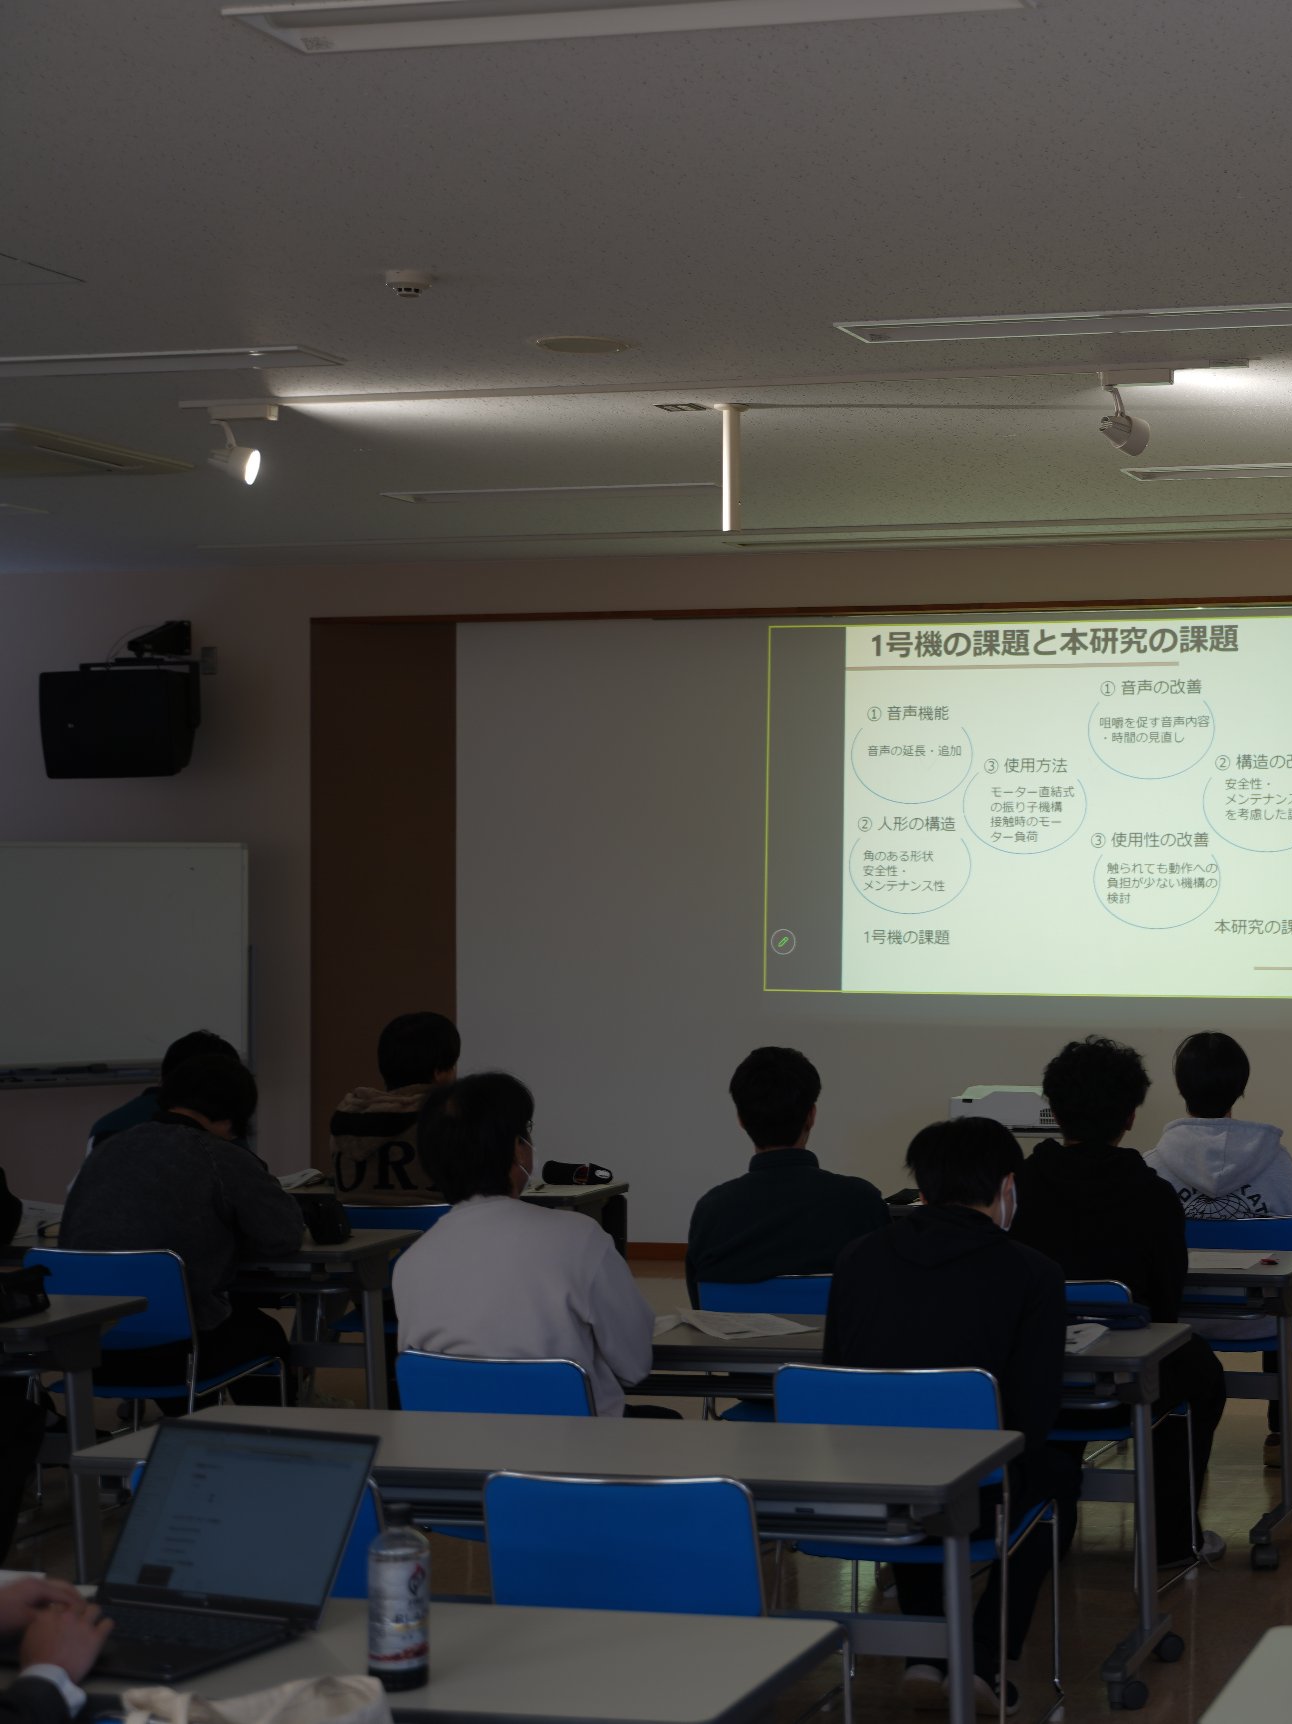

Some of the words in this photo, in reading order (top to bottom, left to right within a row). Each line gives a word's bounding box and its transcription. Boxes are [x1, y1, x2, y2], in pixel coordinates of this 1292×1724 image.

[871, 624, 1239, 658] 1号機の課題と本研究の課題
[1121, 678, 1203, 696] 音声の改善
[887, 705, 950, 722] 音声機能
[1004, 757, 1068, 774] 使用方法
[991, 786, 1075, 798] モーター直結式
[990, 801, 1063, 814] の振り子機構
[877, 816, 957, 832] 人形の構造
[990, 815, 1062, 828] 接触時のモー
[990, 831, 1039, 843] ター負荷
[1111, 831, 1209, 848] 使用性の改善
[863, 850, 934, 863] 角のある形状
[1106, 862, 1218, 875] 触られても動作への
[863, 879, 945, 892] メンテナンス性
[1106, 877, 1218, 889] 負担が少ない機構の
[1106, 892, 1131, 905] 検討
[863, 929, 950, 946] 1号機の課題
